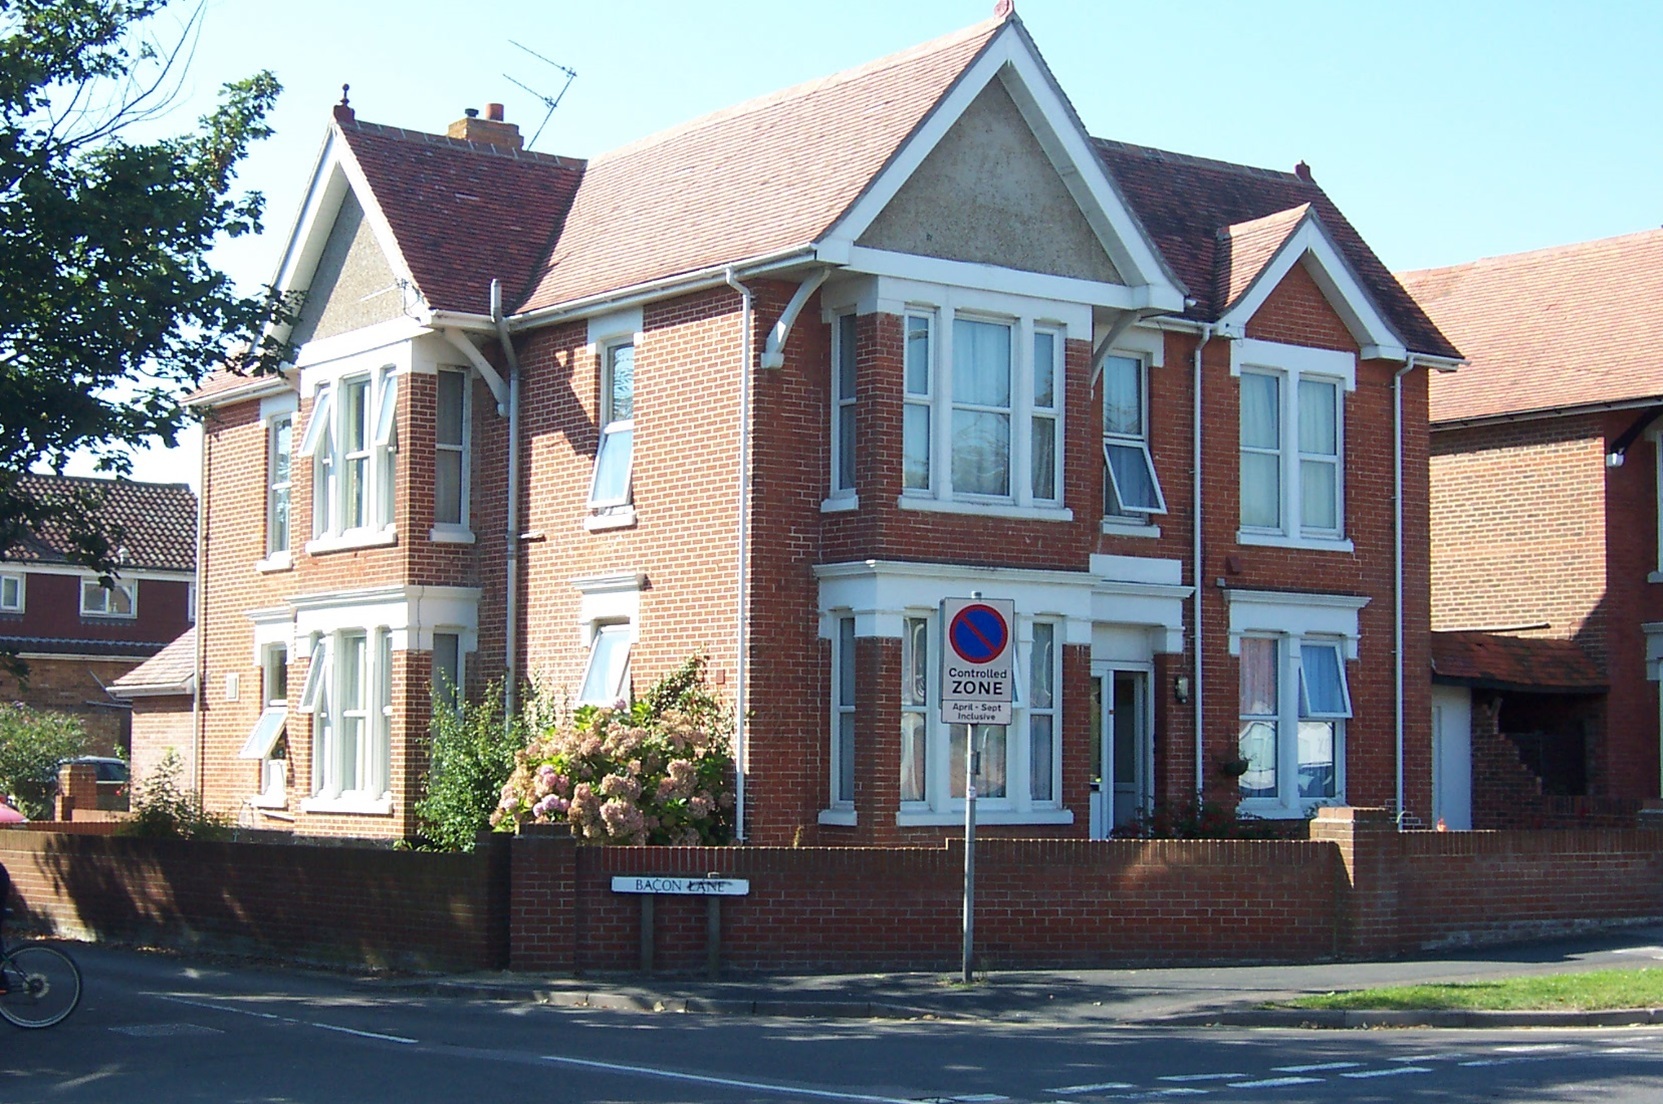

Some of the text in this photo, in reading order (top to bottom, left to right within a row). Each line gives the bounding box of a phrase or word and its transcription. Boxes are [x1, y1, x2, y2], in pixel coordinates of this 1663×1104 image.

[949, 668, 1007, 679] Controlled
[952, 681, 1003, 695] ZONE
[952, 703, 973, 711] April
[981, 703, 1002, 712] Sept
[635, 879, 682, 891] BACON
